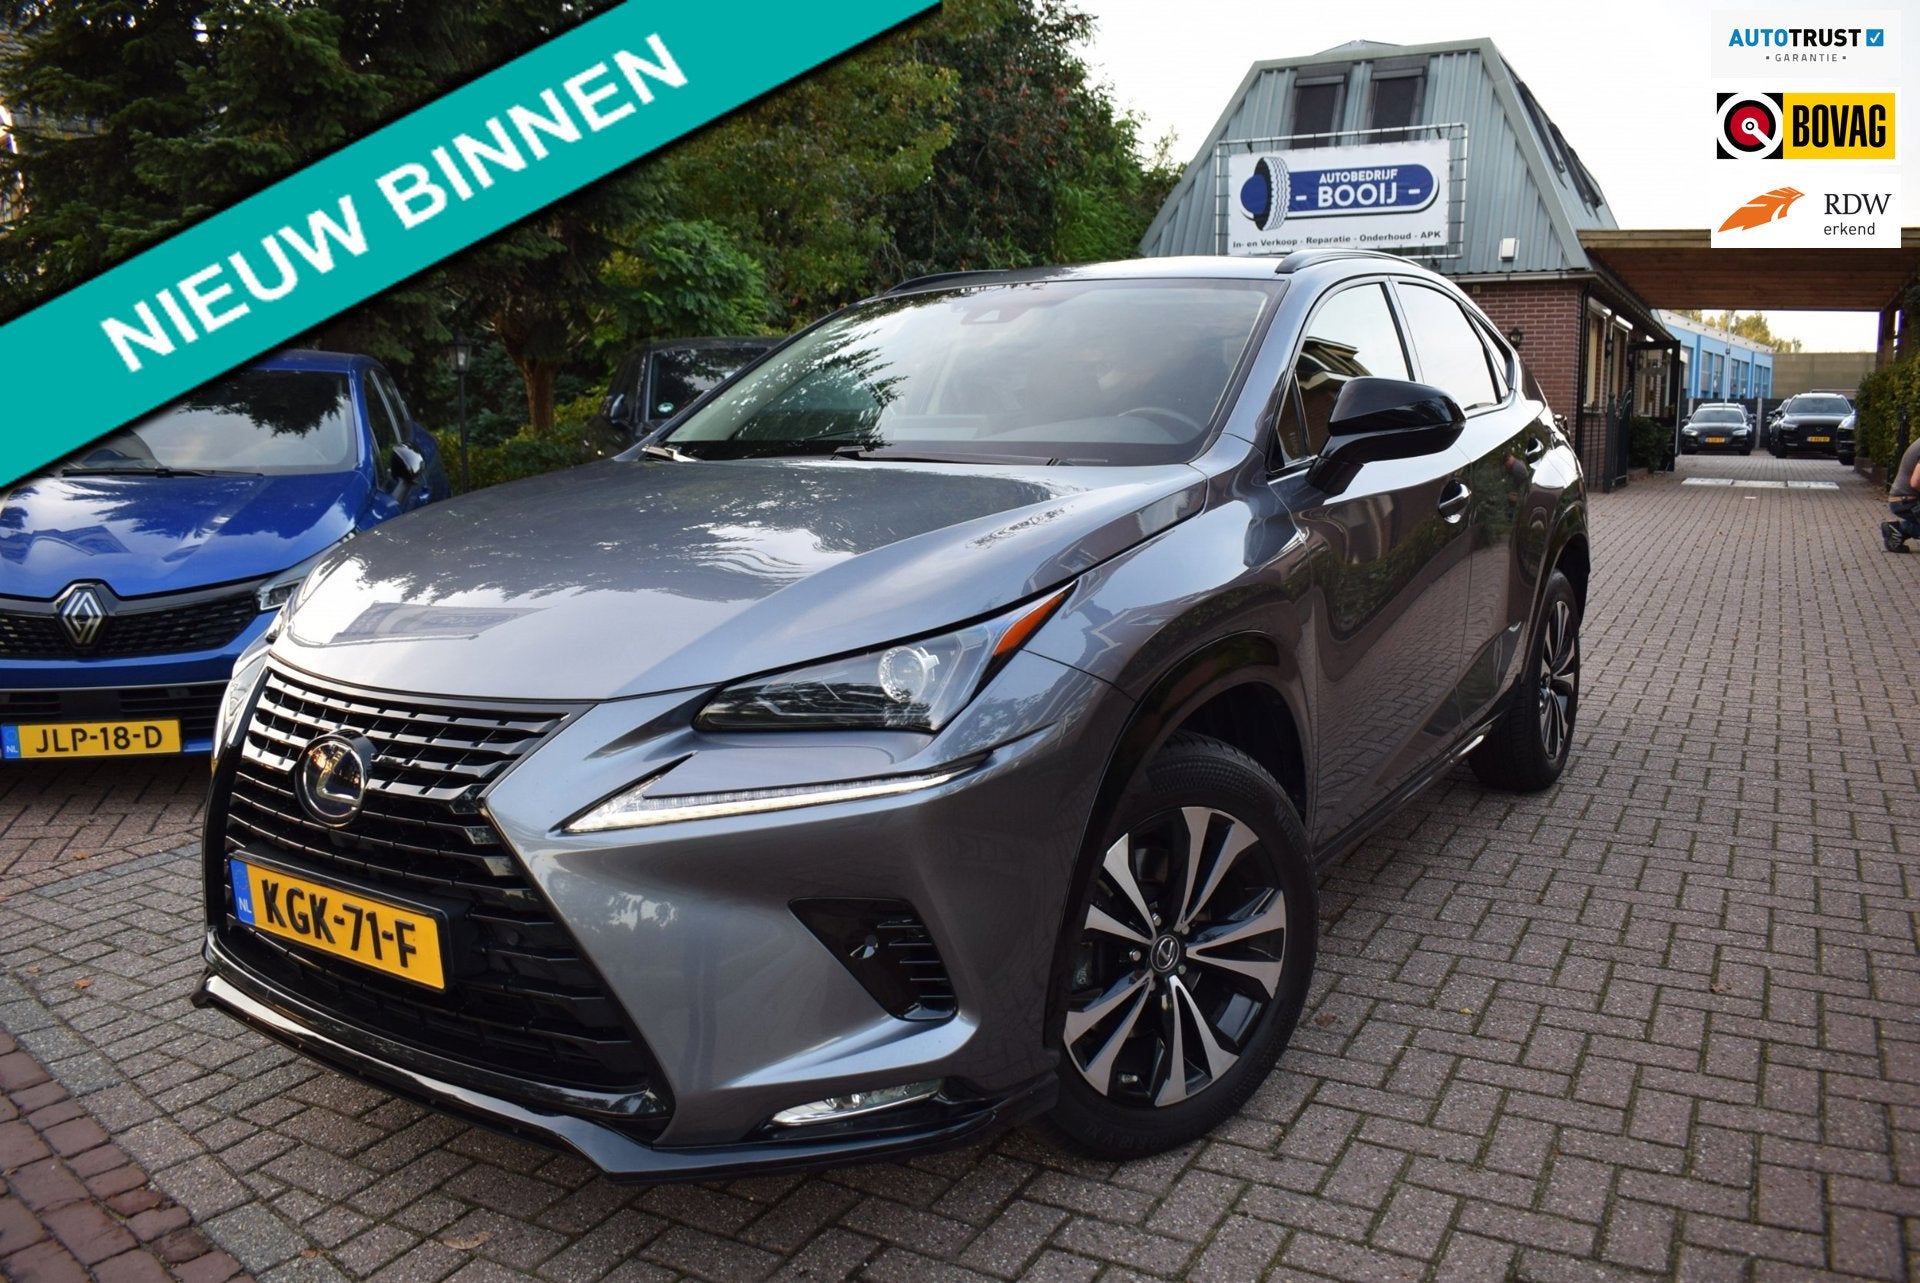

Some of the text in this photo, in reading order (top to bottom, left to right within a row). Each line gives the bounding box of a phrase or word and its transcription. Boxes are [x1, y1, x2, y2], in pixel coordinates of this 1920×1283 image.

[1319, 168, 1399, 184] AUTOBEDRIJF
[1317, 182, 1397, 208] BOOIJ
[1260, 238, 1298, 248] Verkoop
[1306, 235, 1351, 246] Reparatie
[1359, 232, 1412, 242] Onderhoud
[1420, 231, 1441, 239] APK
[36, 725, 163, 753] JLP-18-D
[6, 745, 19, 753] NL
[238, 897, 252, 914] NL
[261, 879, 417, 968] KGK-71-F
